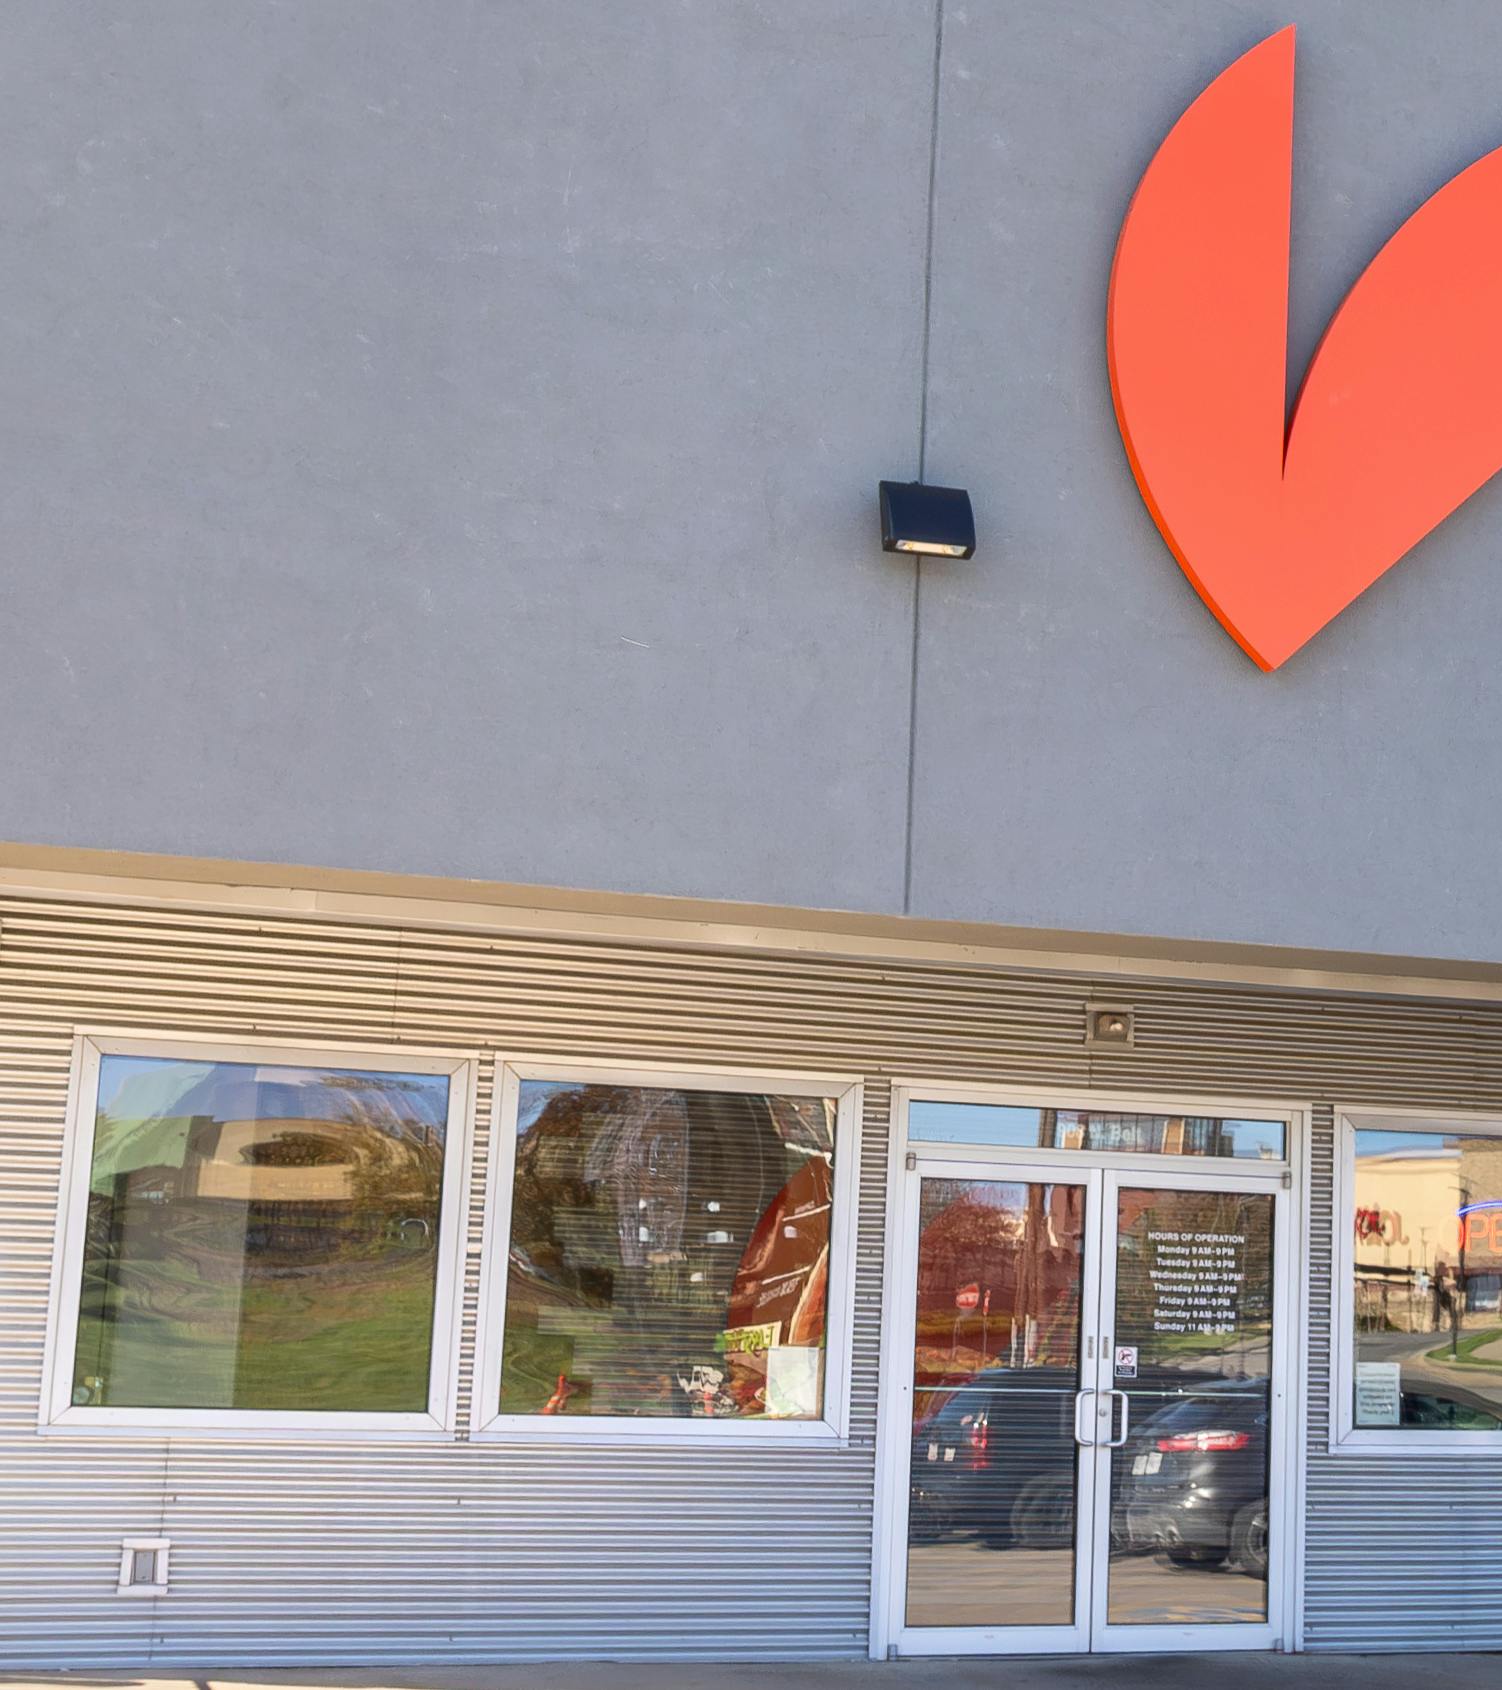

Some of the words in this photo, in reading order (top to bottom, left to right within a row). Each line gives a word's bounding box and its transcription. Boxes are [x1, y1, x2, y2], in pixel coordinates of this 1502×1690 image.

[1148, 1232, 1180, 1241] HOURS
[1181, 1233, 1193, 1241] OF
[1194, 1233, 1245, 1244] OPERATION
[1157, 1245, 1190, 1255] Monday
[1156, 1257, 1191, 1268] Tuesday
[1149, 1270, 1197, 1281] Wednesday
[1154, 1283, 1193, 1294] Thursday
[1159, 1296, 1186, 1306] Friday
[1154, 1309, 1191, 1320] Saturday
[1154, 1321, 1186, 1333] Sunday
